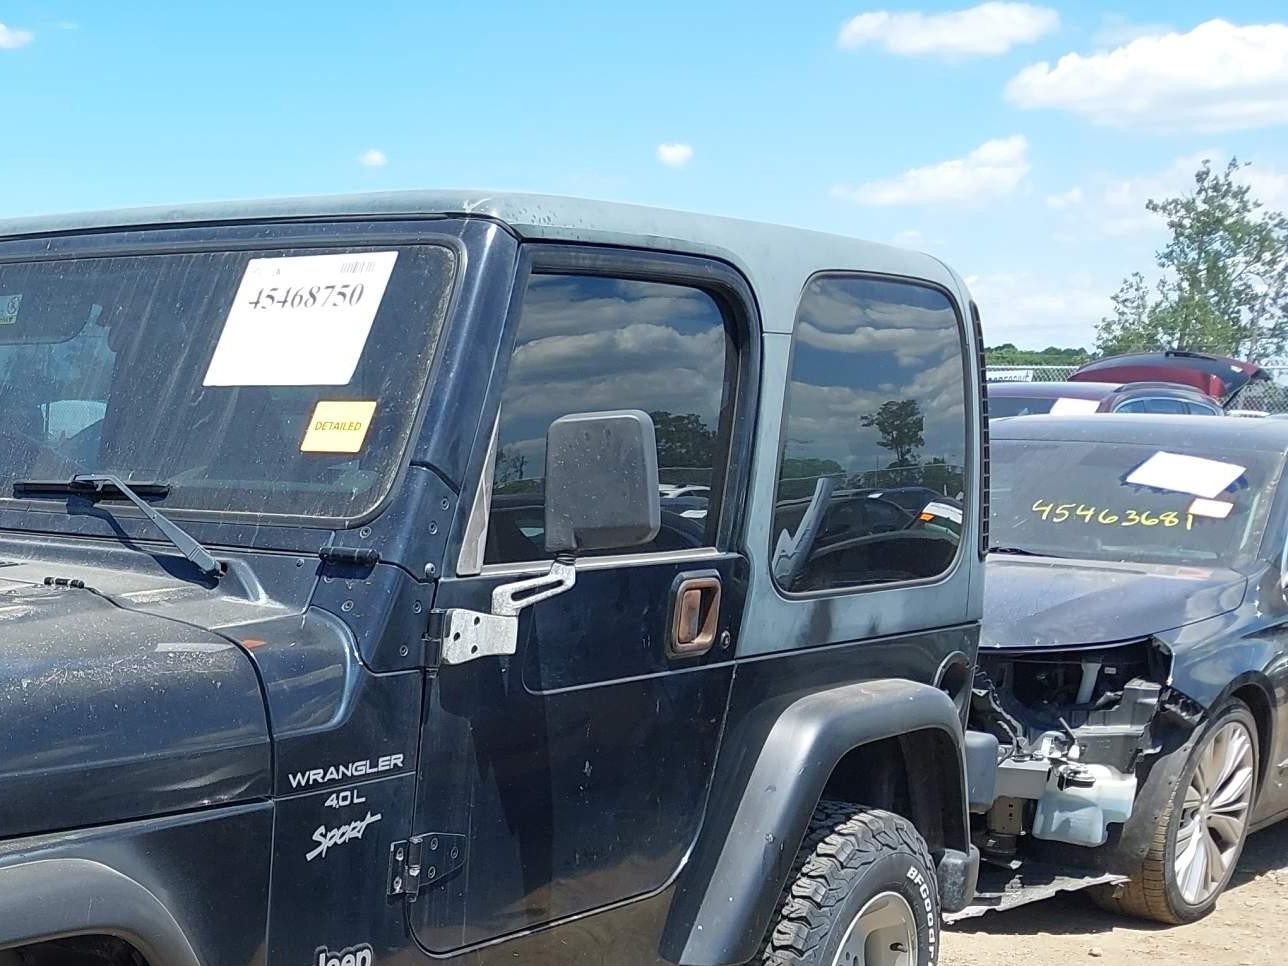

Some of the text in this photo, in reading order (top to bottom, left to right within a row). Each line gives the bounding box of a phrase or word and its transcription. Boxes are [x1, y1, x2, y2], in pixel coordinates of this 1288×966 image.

[249, 283, 365, 310] 45468750
[315, 421, 362, 431] DETAILED
[1032, 499, 1193, 530] 45463681
[288, 753, 405, 789] WRANGLER
[305, 811, 382, 862] Sport
